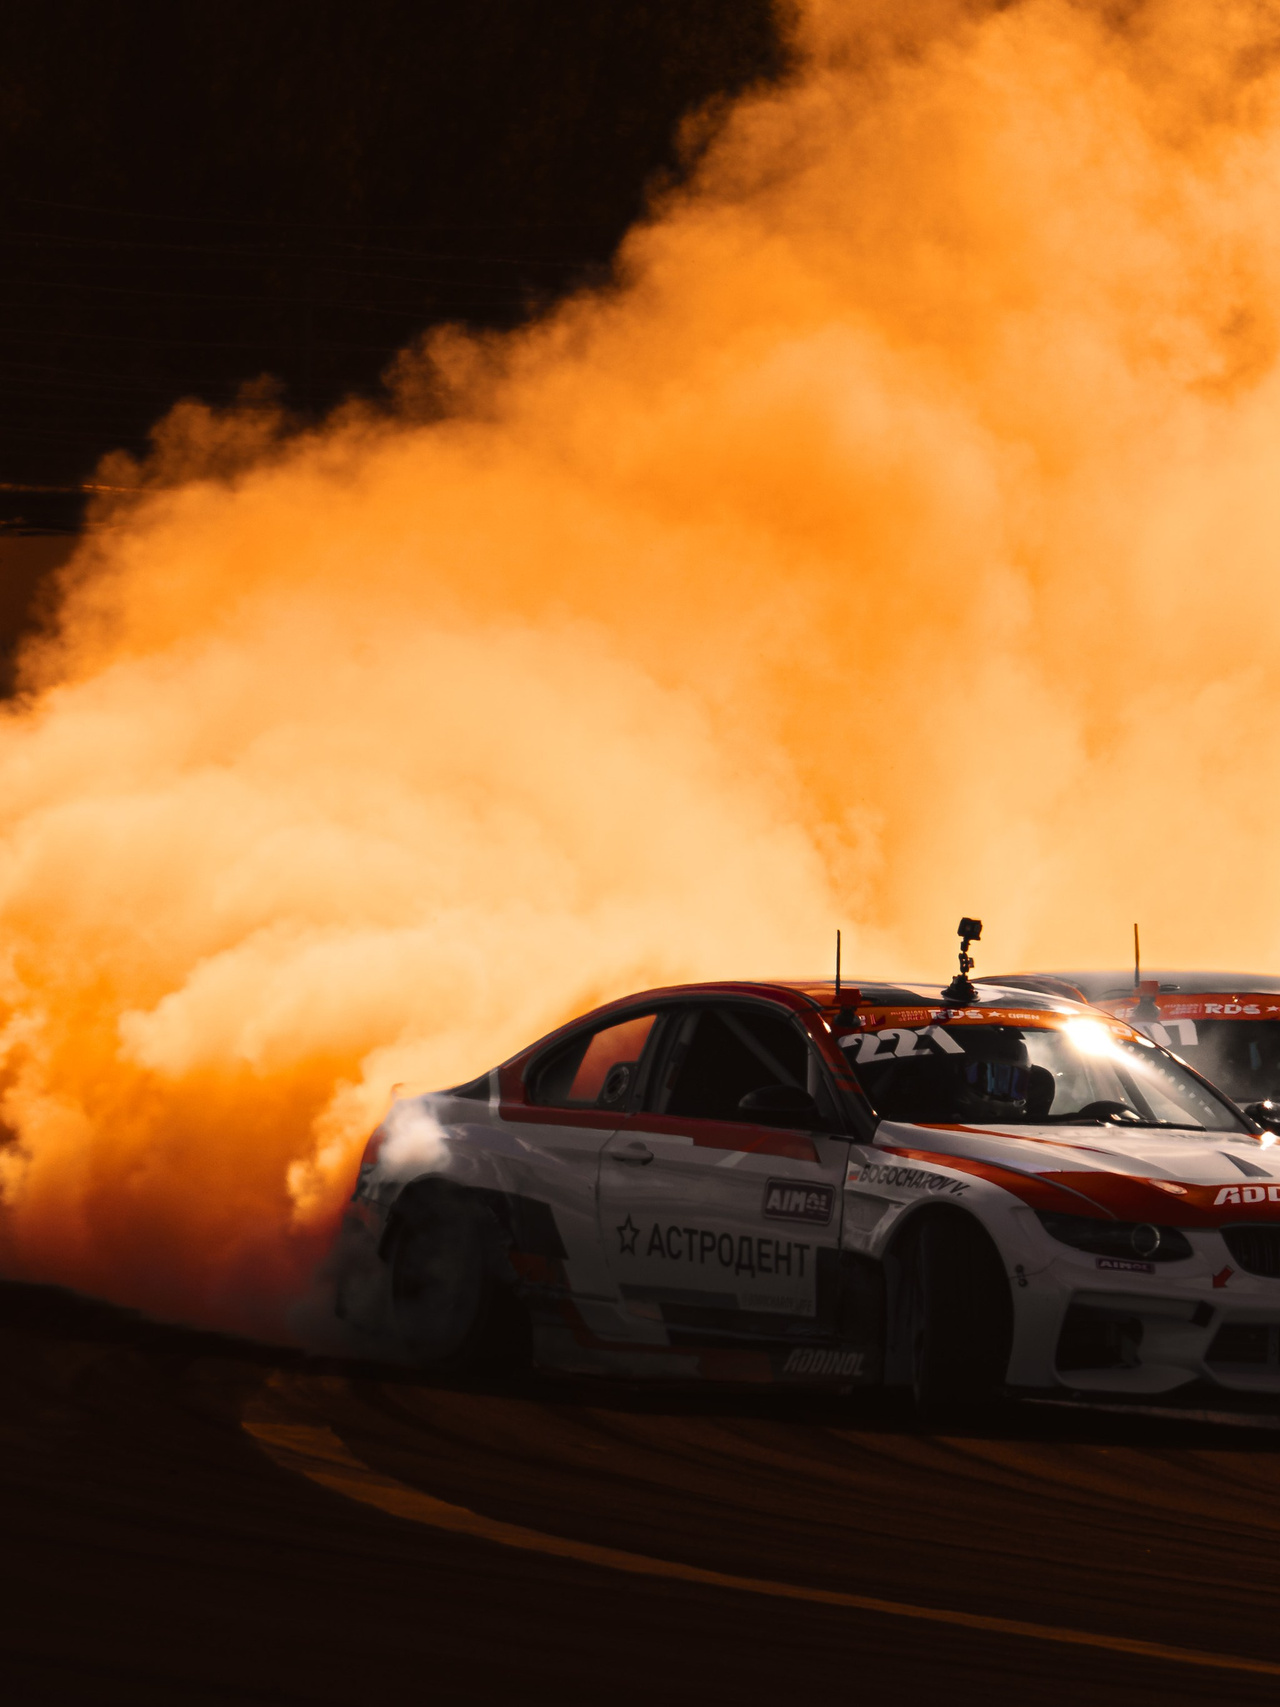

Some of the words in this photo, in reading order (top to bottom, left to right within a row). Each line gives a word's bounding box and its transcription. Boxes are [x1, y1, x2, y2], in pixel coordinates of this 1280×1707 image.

[928, 1009, 985, 1020] RDS
[1205, 1003, 1260, 1014] RDS
[838, 1025, 966, 1064] 221
[861, 1164, 957, 1191] BOGOCHAROV
[766, 1188, 829, 1213] AIMOL
[646, 1223, 810, 1278] АСТРОДЕНТ
[1100, 1260, 1149, 1272] AIMOL
[783, 1347, 865, 1376] ADDINOL
